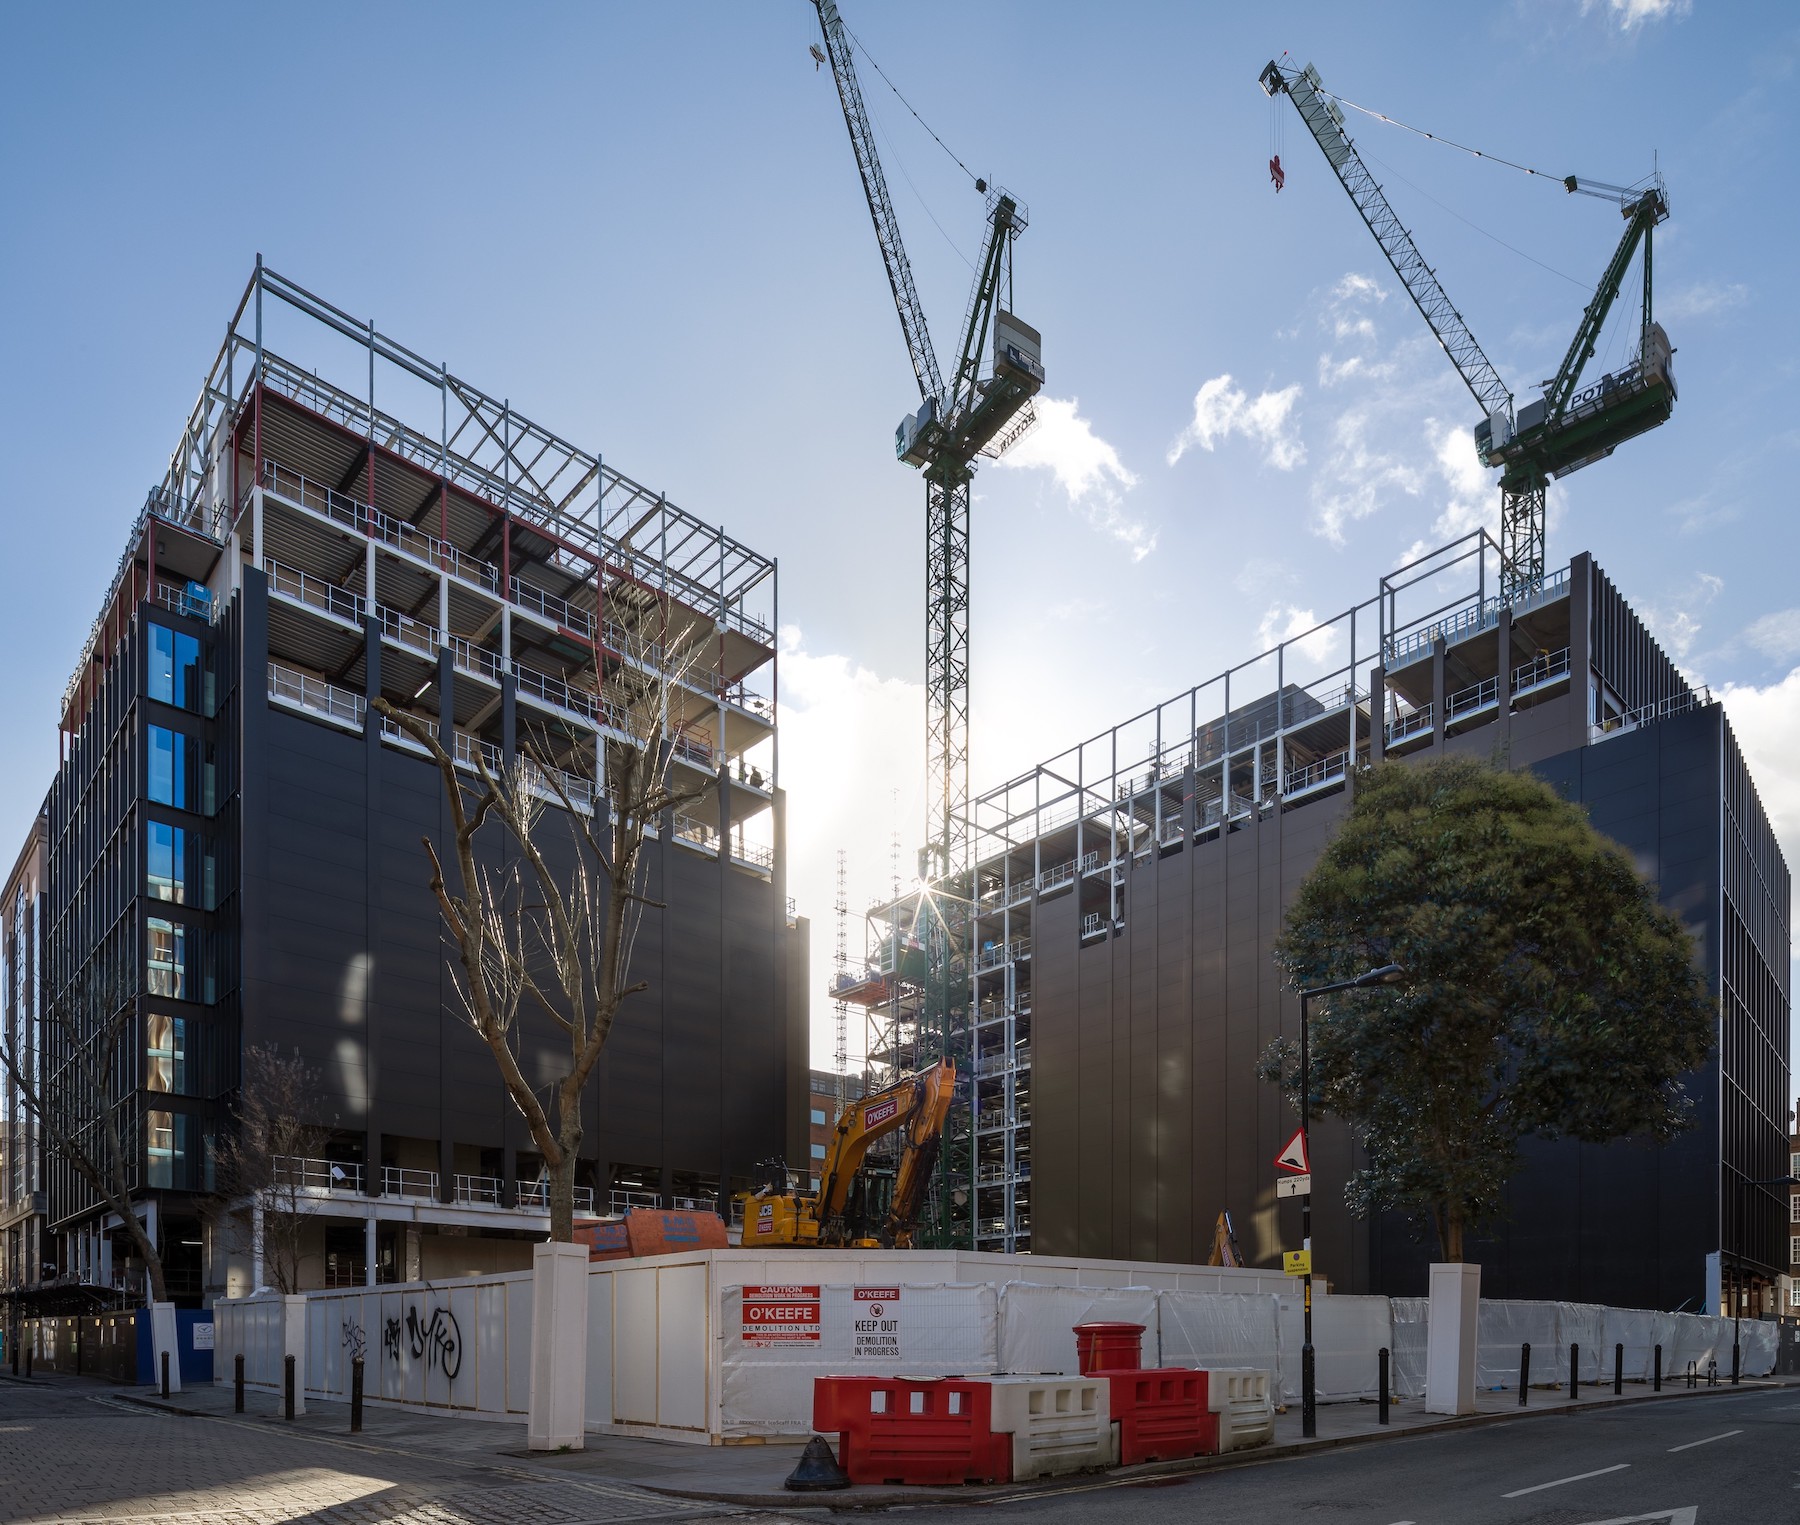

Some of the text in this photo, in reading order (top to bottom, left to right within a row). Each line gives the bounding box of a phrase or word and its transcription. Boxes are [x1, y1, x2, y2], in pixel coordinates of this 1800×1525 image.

[759, 1204, 773, 1217] JCB
[760, 1286, 803, 1294] CAUTION
[858, 1290, 896, 1299] O'KEEFE
[749, 1307, 813, 1320] O'KEEFE
[855, 1320, 898, 1332] KEEP OUT
[856, 1336, 897, 1346] DEMOLITION
[854, 1347, 899, 1356] IN PROGRESS
